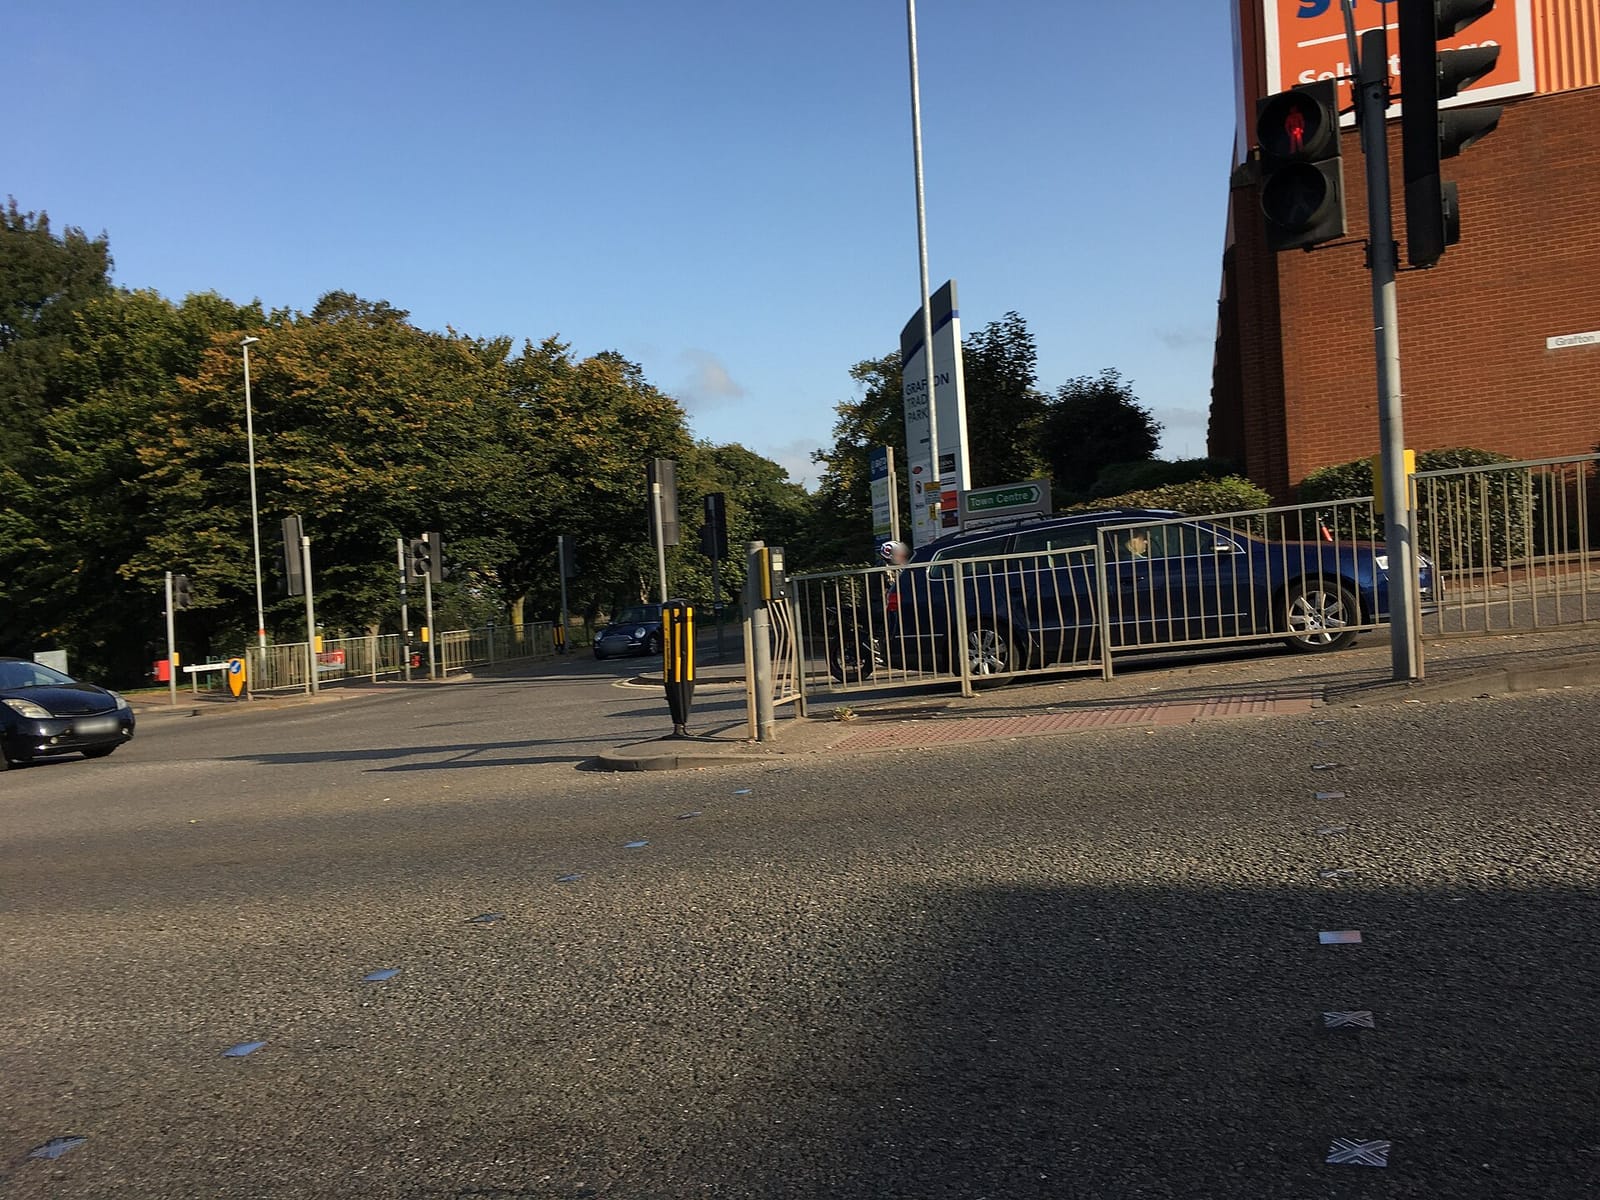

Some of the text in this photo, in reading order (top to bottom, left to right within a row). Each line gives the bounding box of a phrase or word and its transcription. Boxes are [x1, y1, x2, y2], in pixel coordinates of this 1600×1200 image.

[907, 373, 949, 395] GRAFON
[907, 394, 928, 407] TRAD
[970, 497, 993, 506] Town
[996, 492, 1028, 504] Centre
